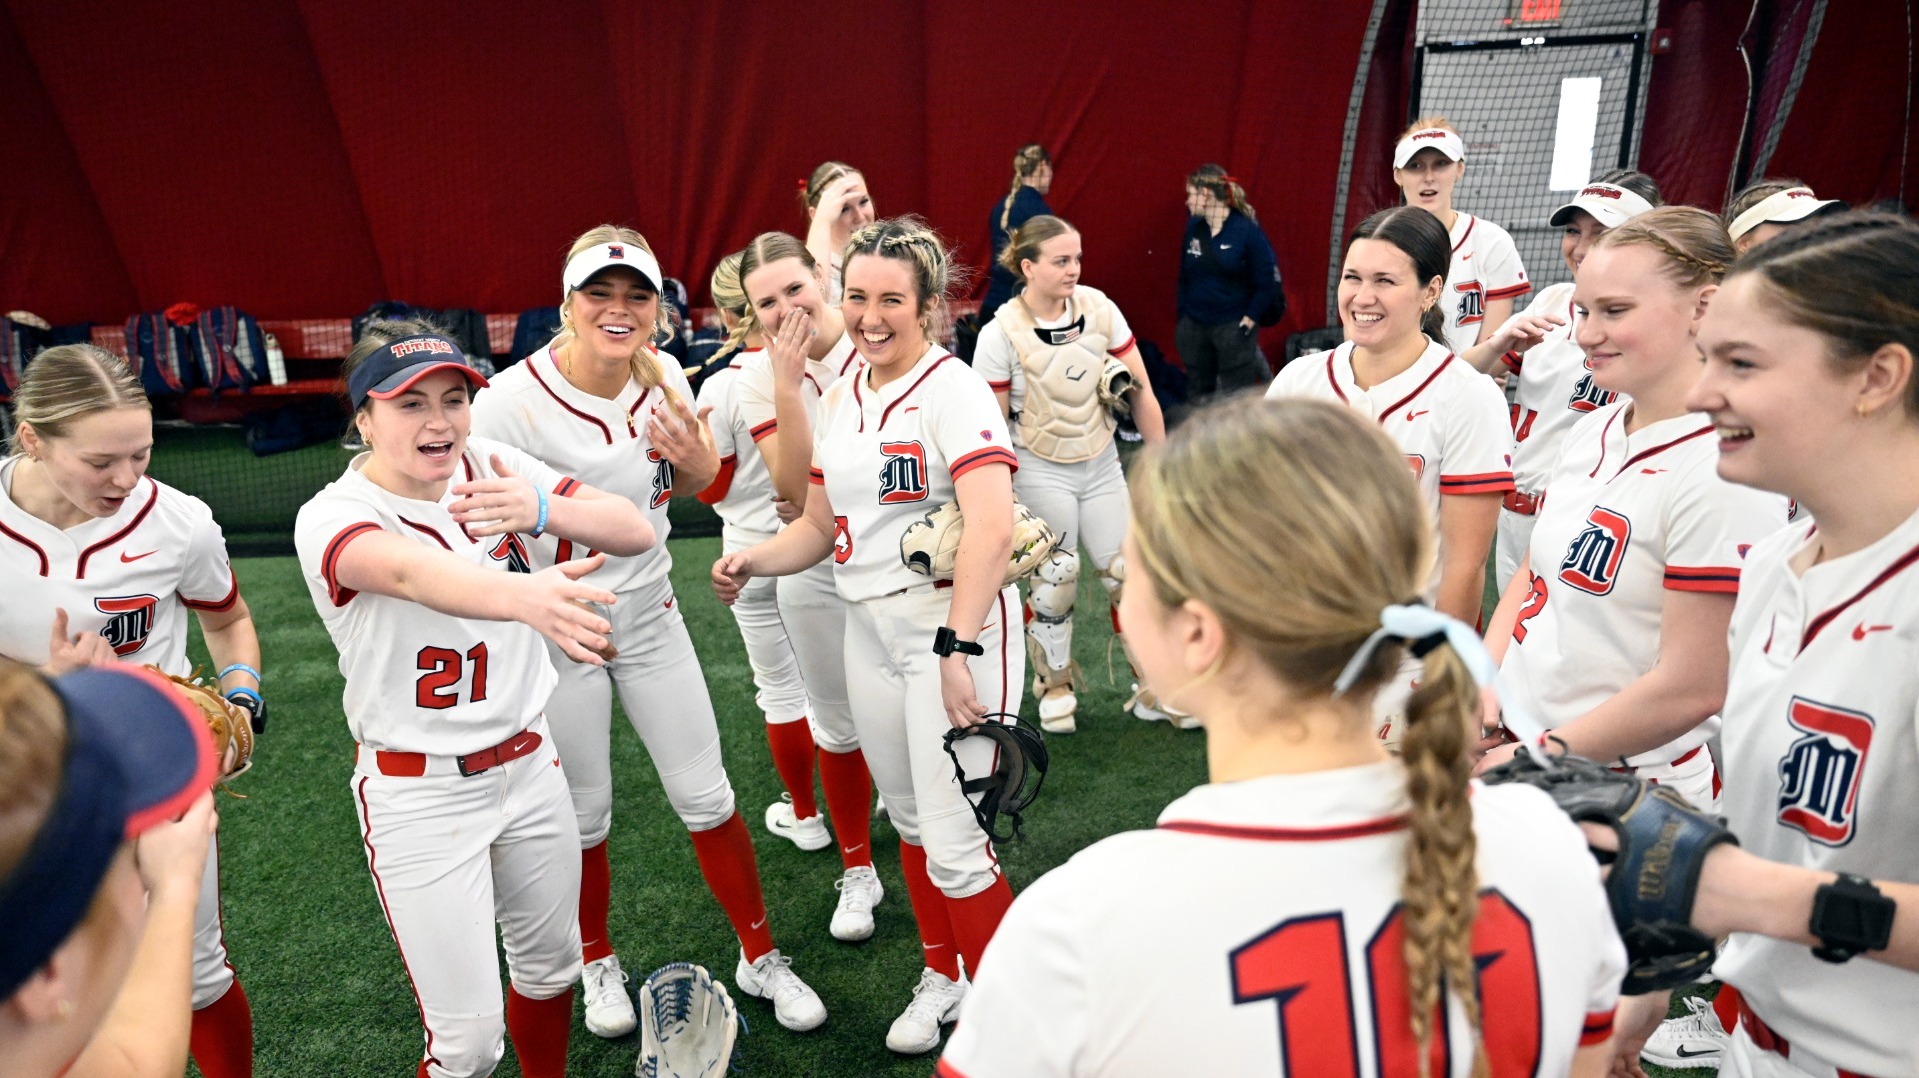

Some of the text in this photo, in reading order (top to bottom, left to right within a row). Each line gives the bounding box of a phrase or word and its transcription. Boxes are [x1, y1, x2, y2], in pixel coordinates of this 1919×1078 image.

[390, 340, 453, 358] TITANS
[416, 640, 489, 710] 21
[1228, 886, 1543, 1078] 10
